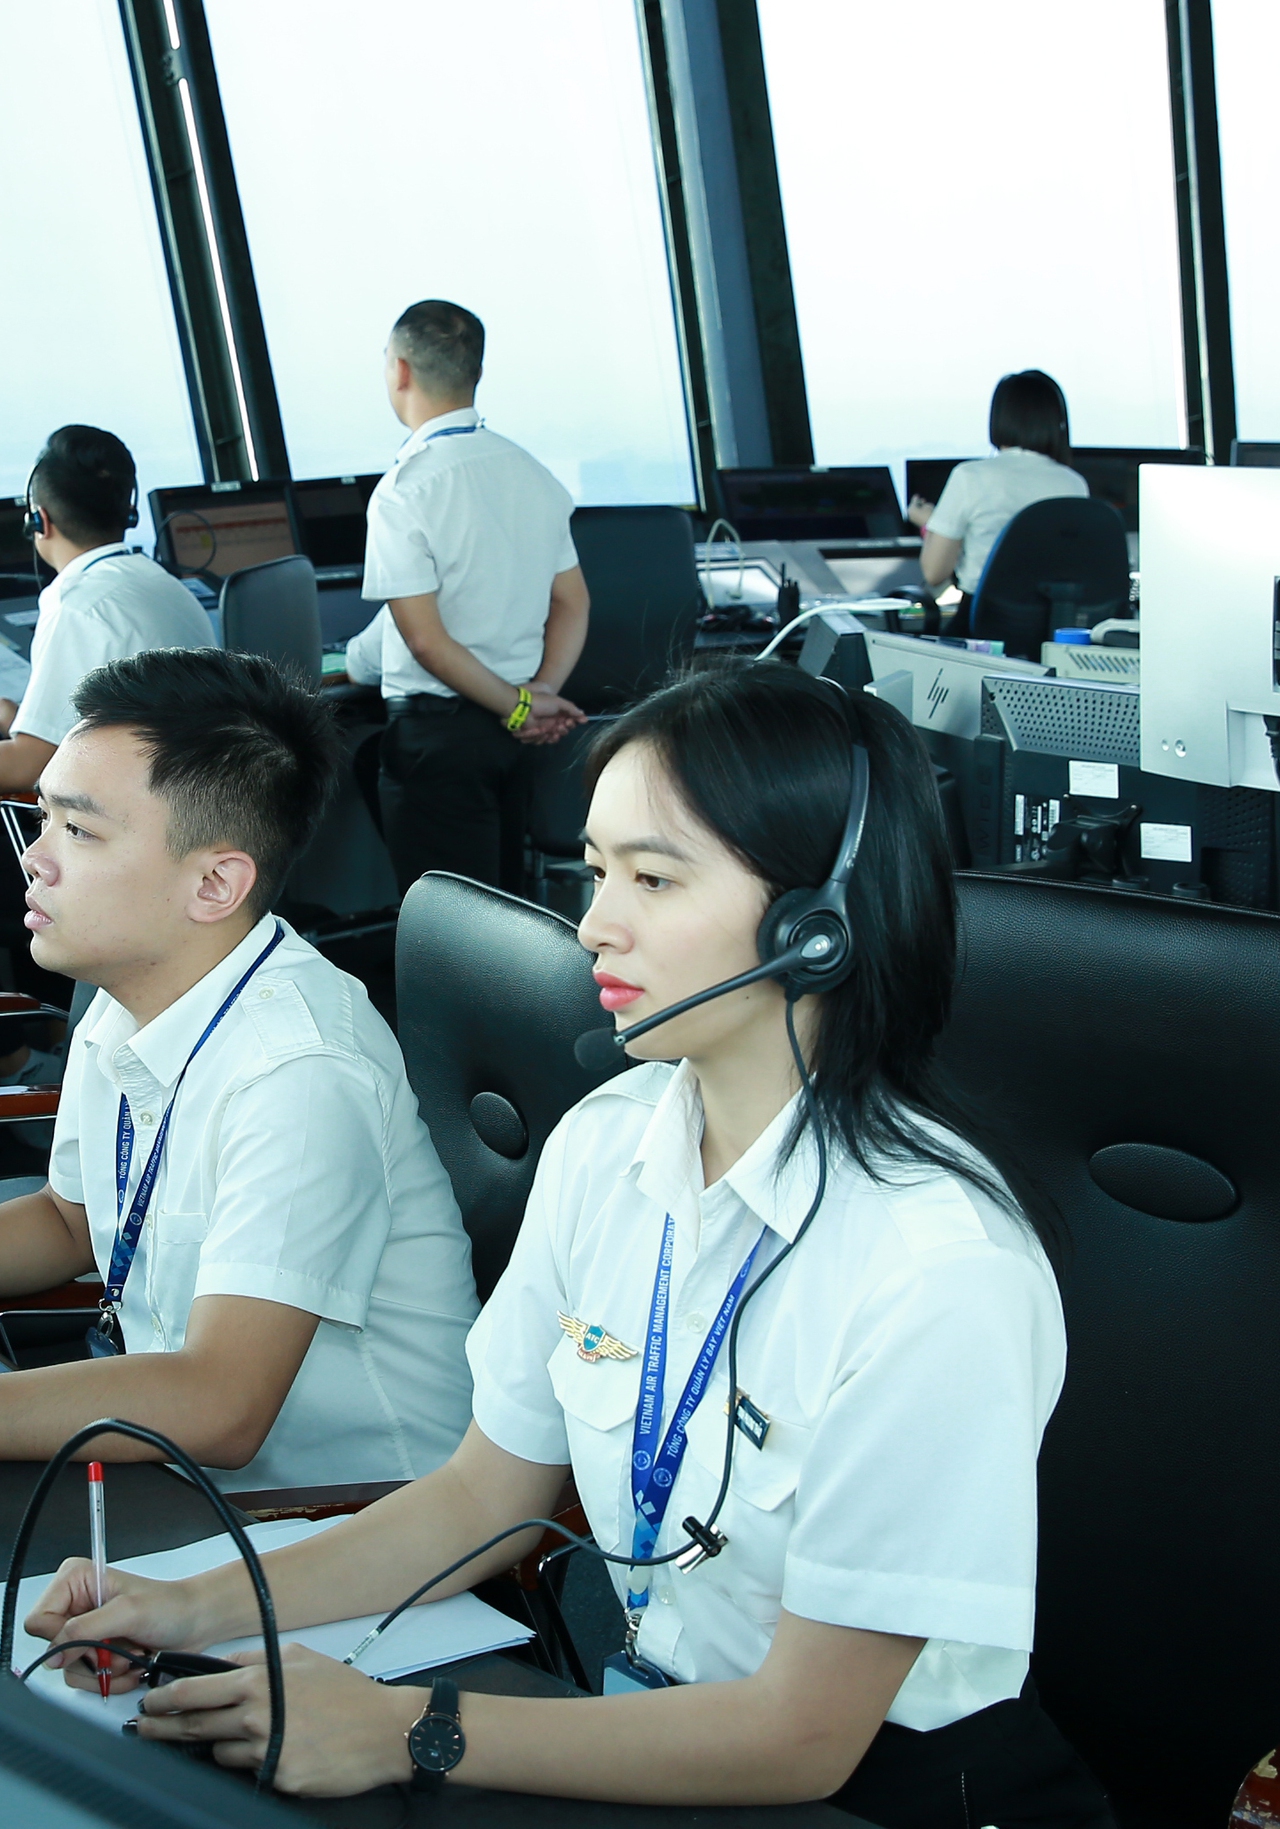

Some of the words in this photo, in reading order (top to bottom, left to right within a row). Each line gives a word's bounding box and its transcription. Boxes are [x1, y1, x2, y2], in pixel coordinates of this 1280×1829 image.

[122, 1130, 131, 1141] TY
[662, 1218, 676, 1267] CORPORAT
[653, 1269, 670, 1333] MANAGEMENT
[586, 1332, 600, 1344] ATC
[647, 1335, 662, 1373] TRAFFIC
[645, 1374, 658, 1393] AIR
[666, 1434, 683, 1459] TỔNG
[685, 1394, 697, 1408] TY
[706, 1336, 718, 1357] BAY
[713, 1317, 726, 1337] VIỆT
[723, 1294, 736, 1317] NAM
[639, 1393, 656, 1435] VIETNAM
